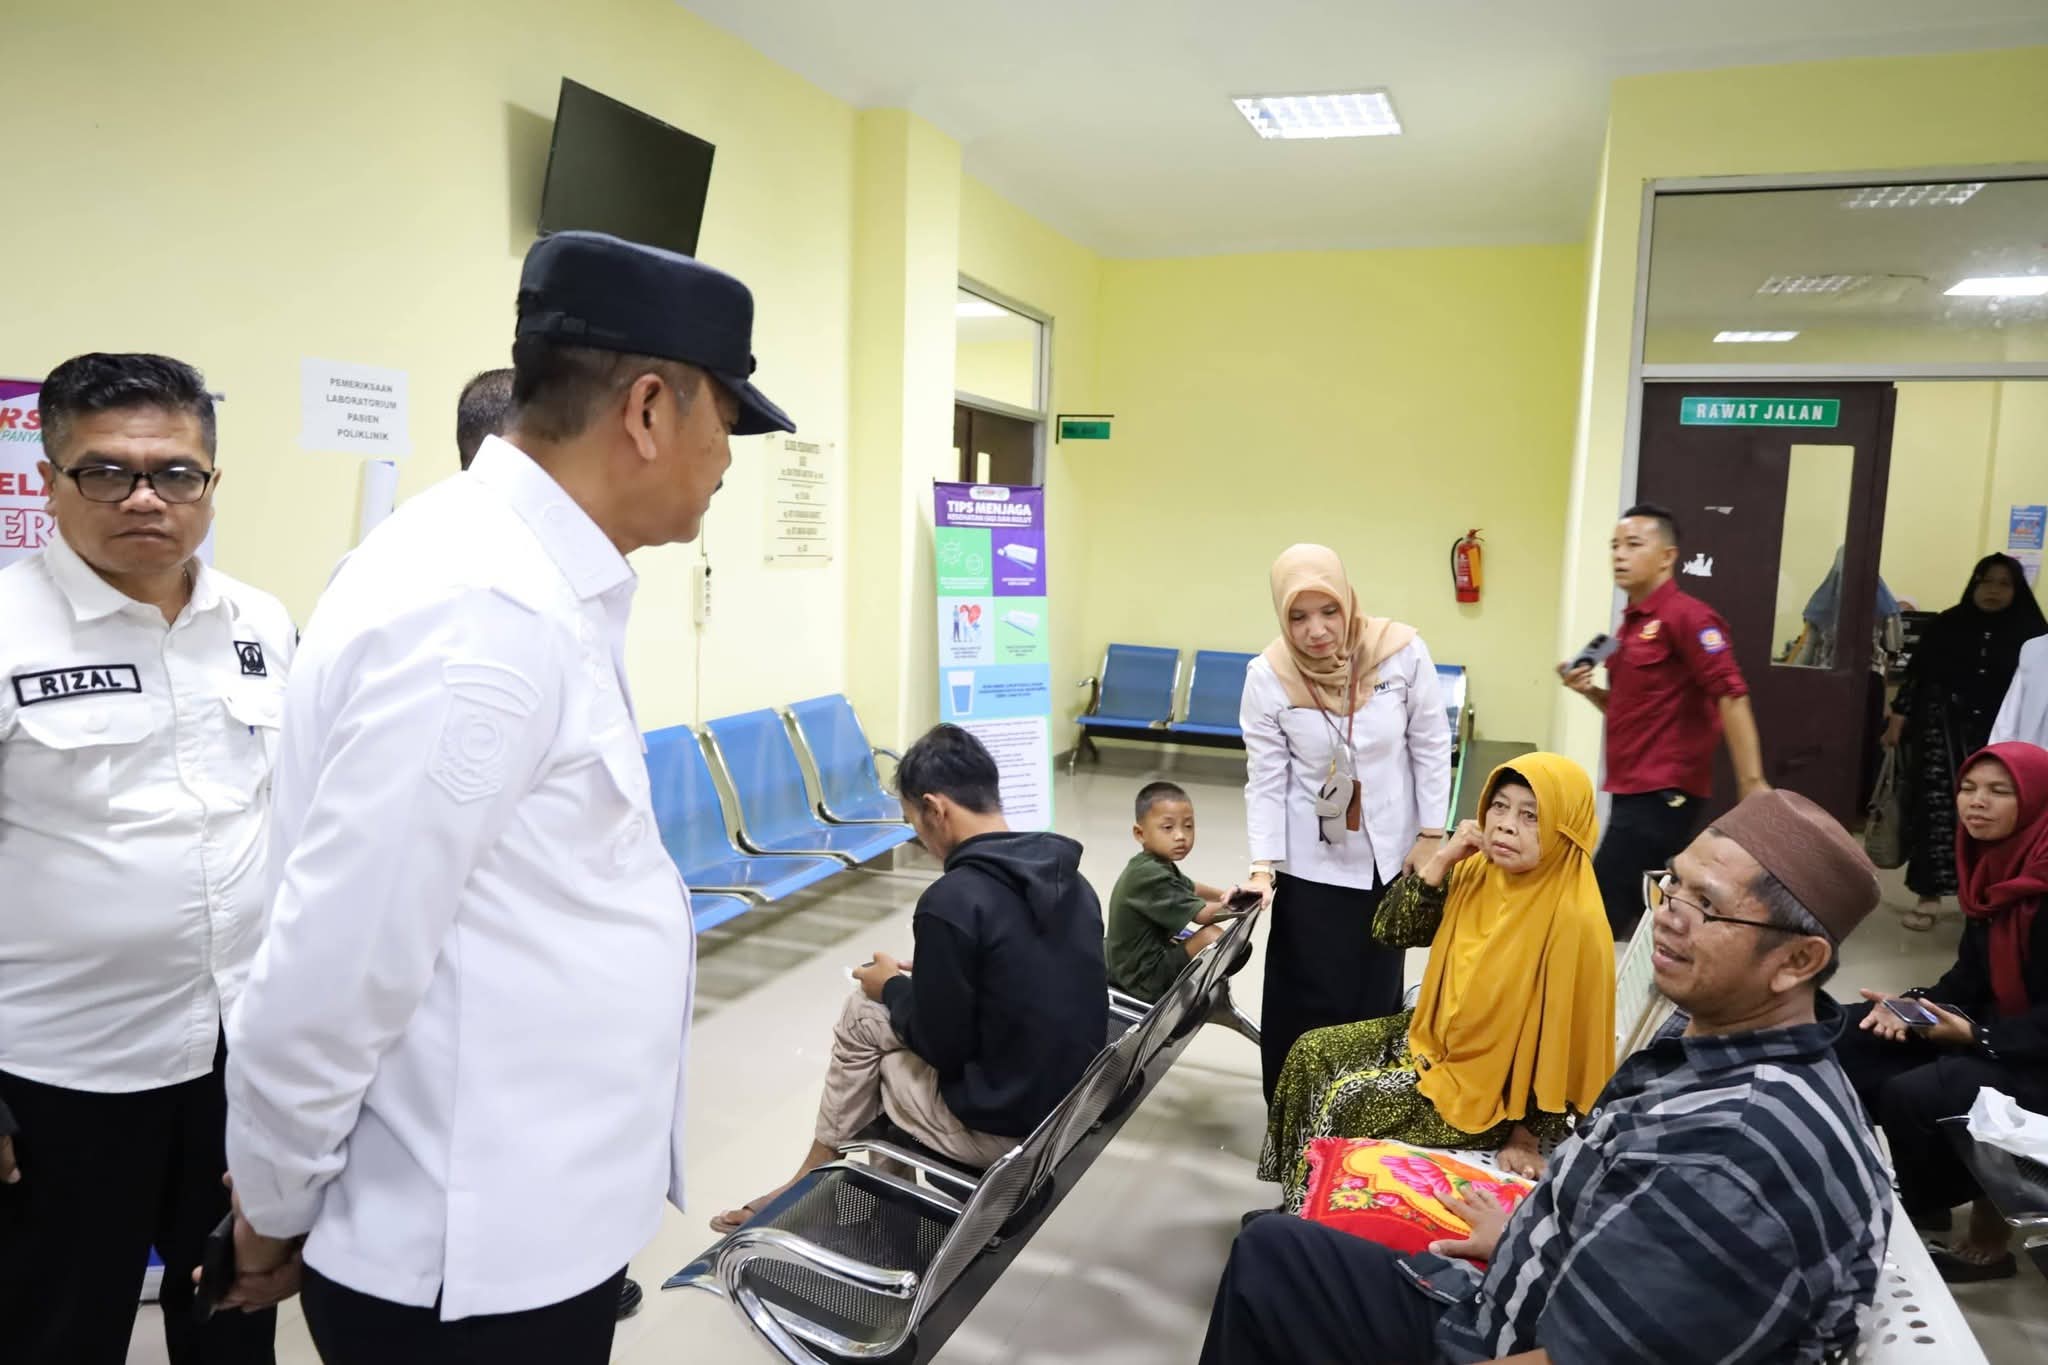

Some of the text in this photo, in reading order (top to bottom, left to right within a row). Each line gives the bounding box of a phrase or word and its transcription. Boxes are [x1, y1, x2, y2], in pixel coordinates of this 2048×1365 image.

[330, 377, 392, 392] PEMERIKSAAN
[326, 394, 397, 408] LABORATORIUM
[347, 413, 379, 424] PASIEN
[1696, 403, 1823, 420] RAWAT JALAN
[337, 428, 389, 440] POLIKLINIK
[947, 501, 1032, 516] TIPS MENJAGA
[40, 670, 121, 695] RIZAL
